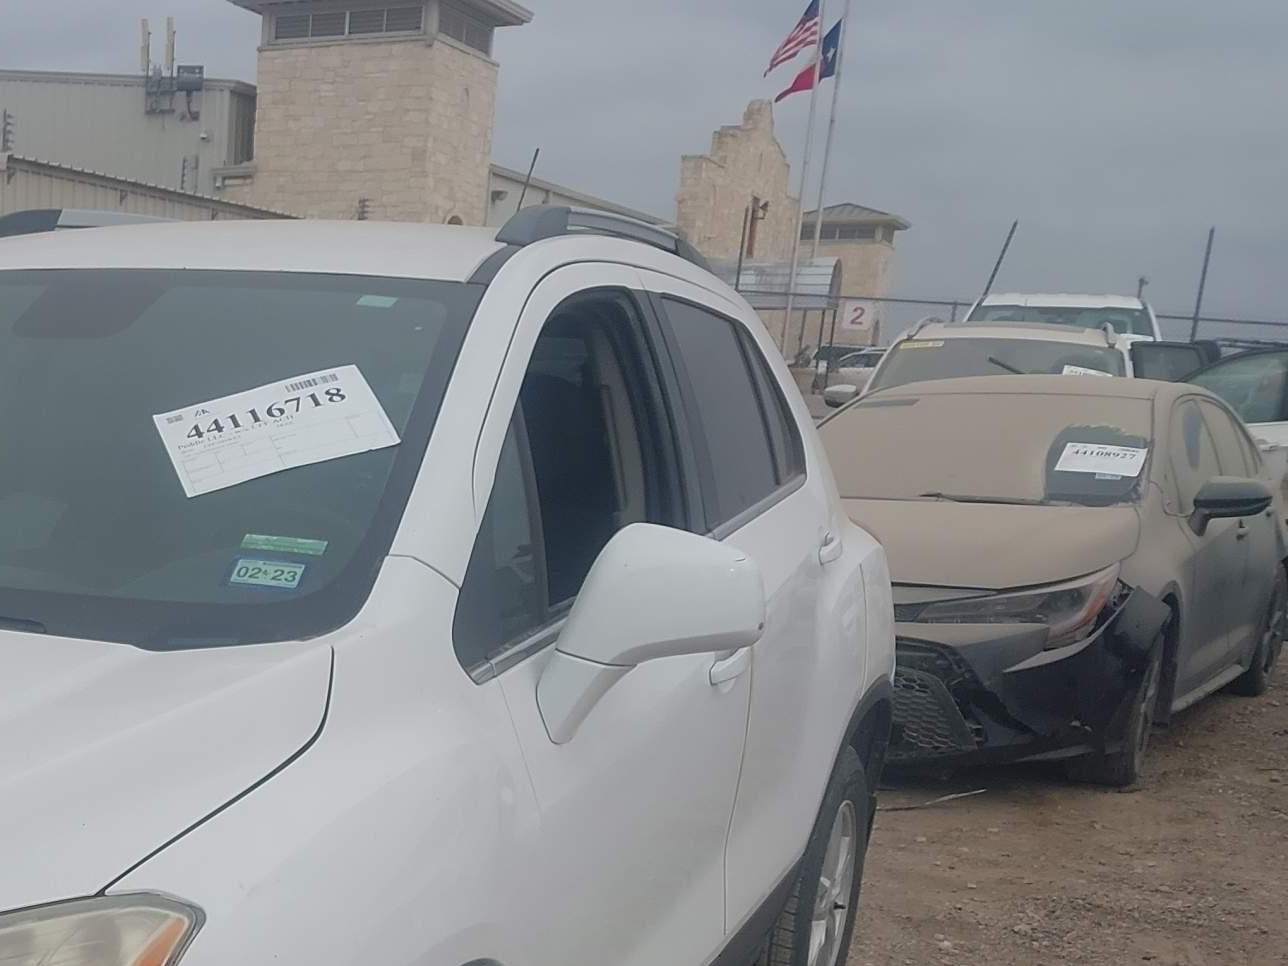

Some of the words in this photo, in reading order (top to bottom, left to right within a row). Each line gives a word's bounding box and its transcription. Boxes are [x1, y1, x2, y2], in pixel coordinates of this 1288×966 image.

[850, 306, 865, 325] 2
[186, 387, 347, 440] 44116718
[236, 566, 262, 579] 02
[270, 569, 298, 582] 23
